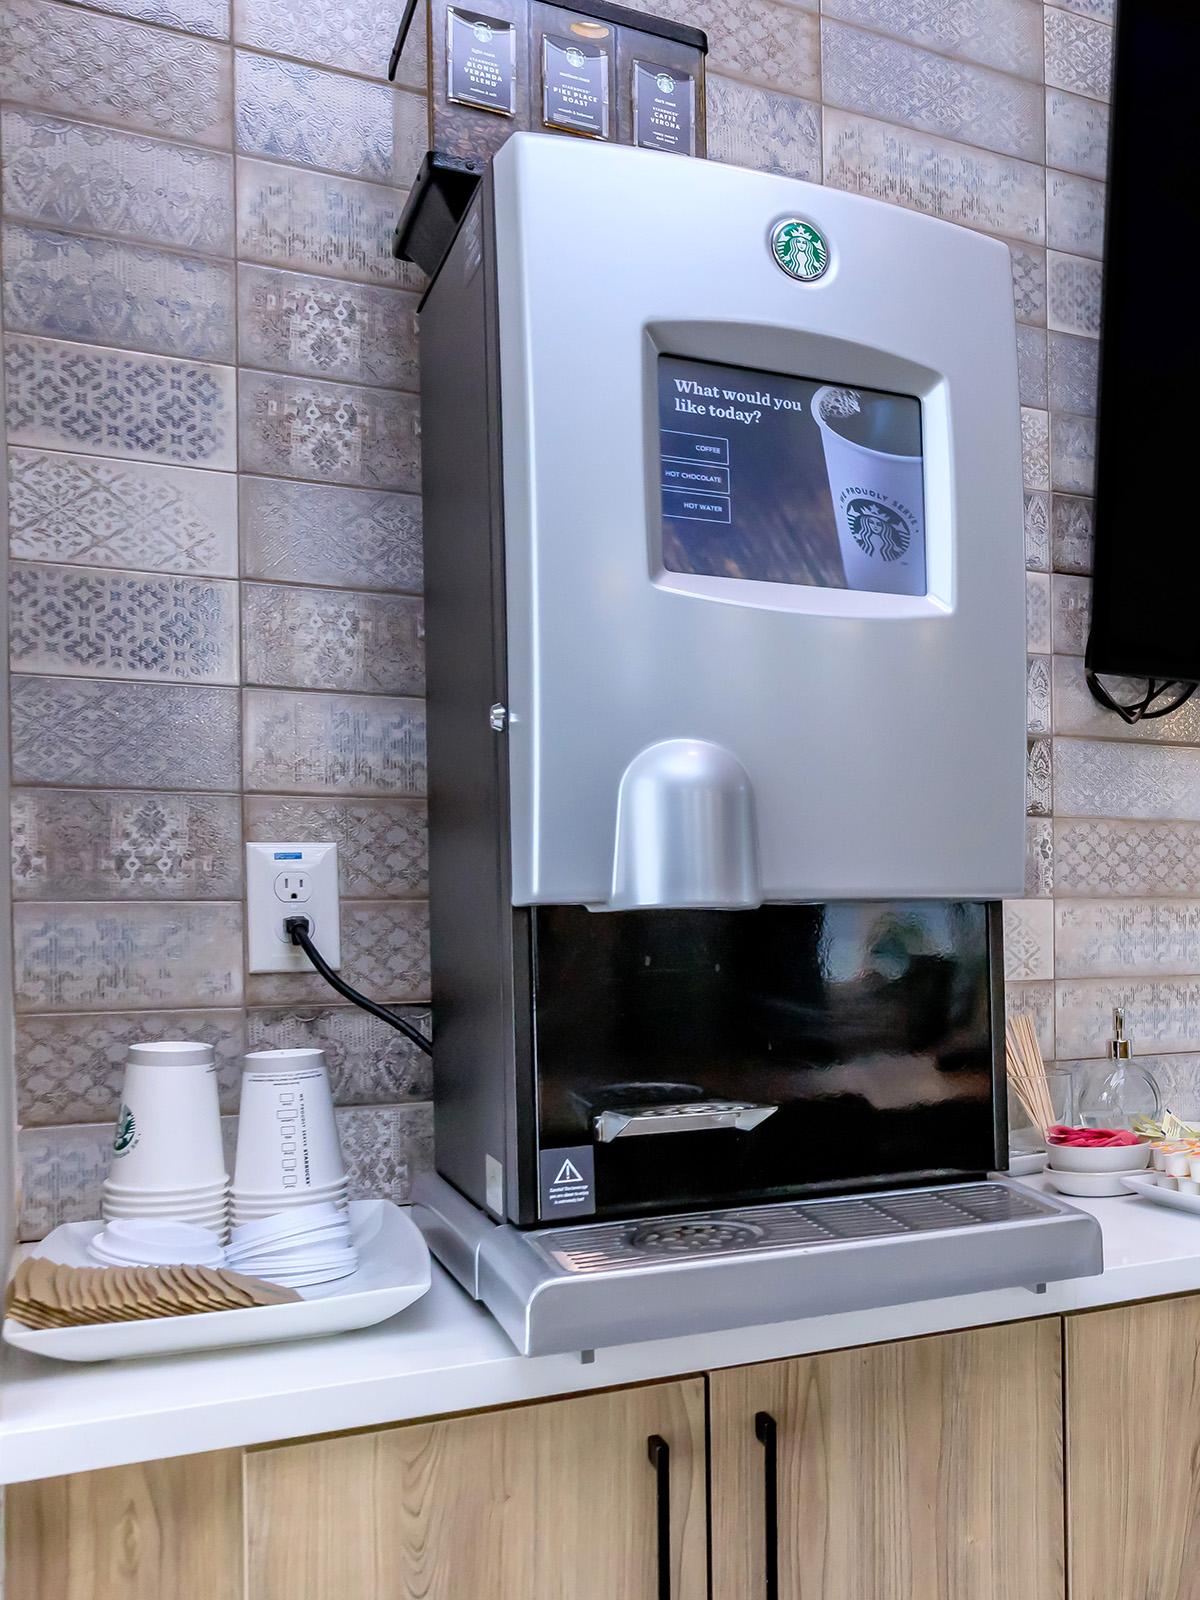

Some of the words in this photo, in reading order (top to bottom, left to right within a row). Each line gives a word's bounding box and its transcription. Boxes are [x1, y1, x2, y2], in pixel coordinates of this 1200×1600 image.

[466, 61, 500, 74] BLONDE
[464, 67, 502, 82] VERANDA
[470, 75, 497, 87] BLEND
[553, 86, 571, 96] PIKE
[573, 92, 598, 103] PLACE
[562, 96, 588, 107] ROAST
[650, 117, 680, 130] VERONA
[674, 378, 720, 398] What
[722, 389, 771, 406] would
[773, 398, 802, 411] you
[674, 398, 706, 415] like
[708, 404, 761, 424] today?
[695, 444, 720, 455] COFFEE
[665, 470, 680, 478] HOT
[681, 472, 722, 483] CHOCOLATE
[699, 504, 723, 512] WATER
[845, 487, 888, 501] PROUDLY
[892, 500, 918, 526] SERVE
